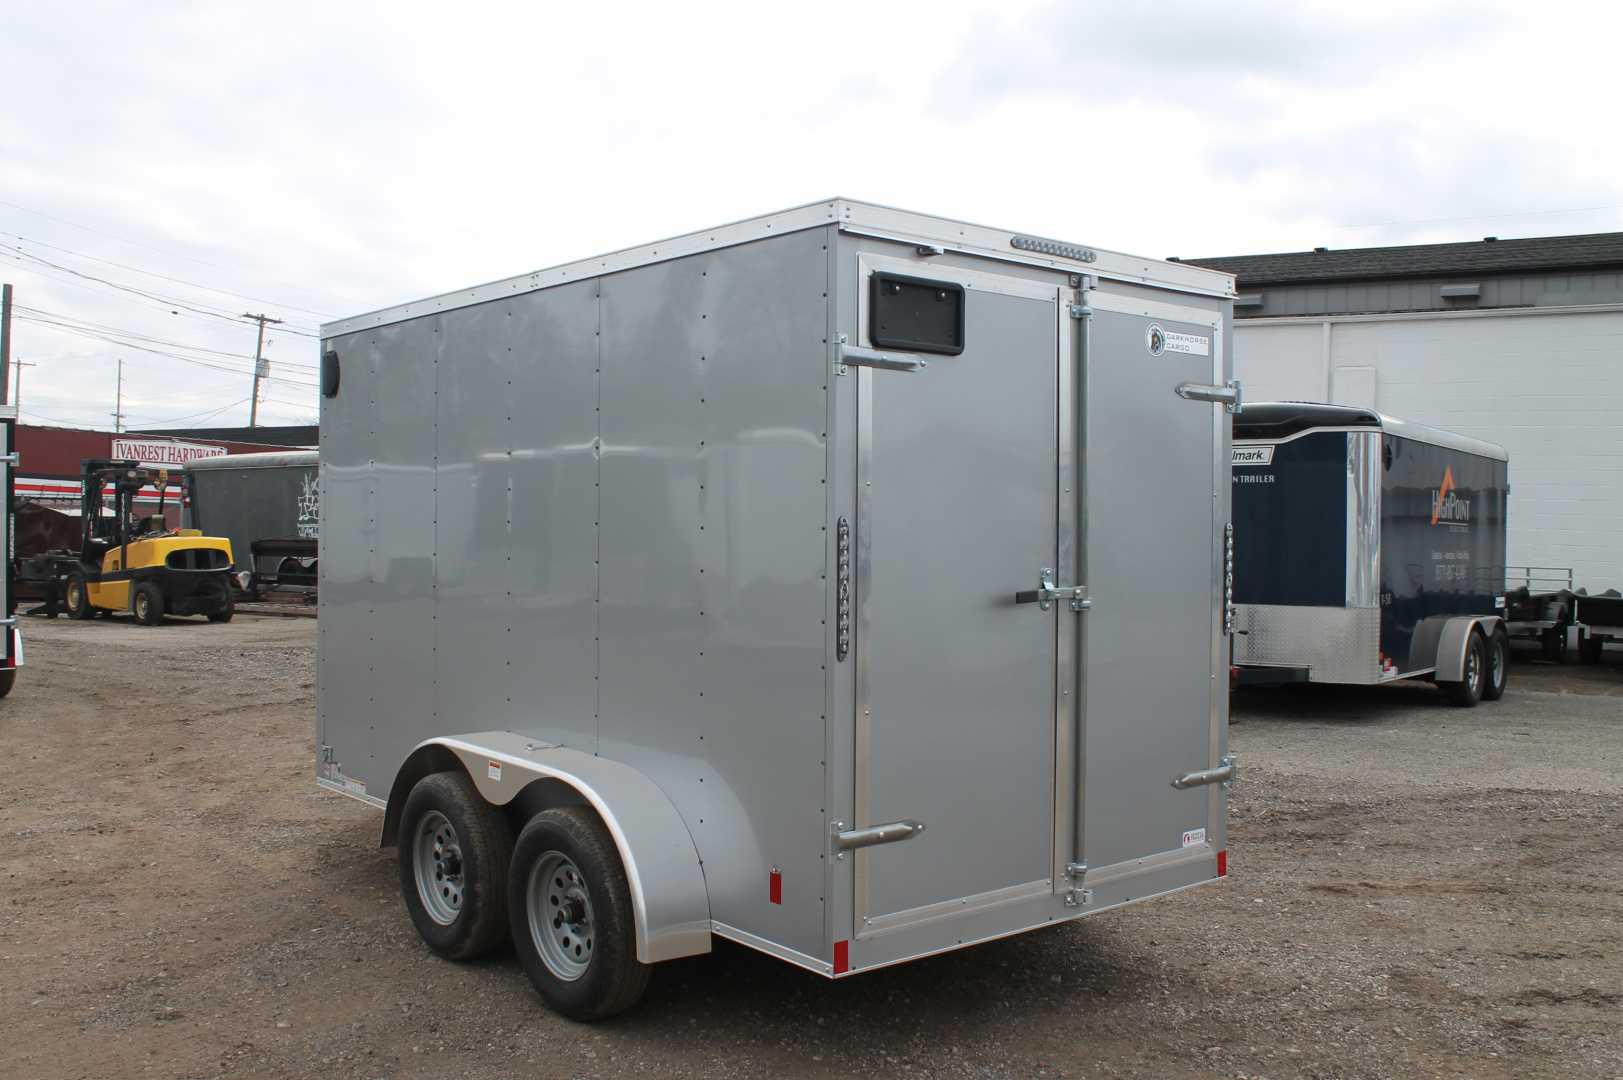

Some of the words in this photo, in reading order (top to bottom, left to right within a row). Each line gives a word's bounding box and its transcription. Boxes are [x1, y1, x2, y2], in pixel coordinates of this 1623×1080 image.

[1166, 333, 1208, 345] DARKHORSE
[1166, 342, 1190, 352] CARGO
[115, 443, 167, 461] IVANREST
[1240, 474, 1275, 483] TRAILER
